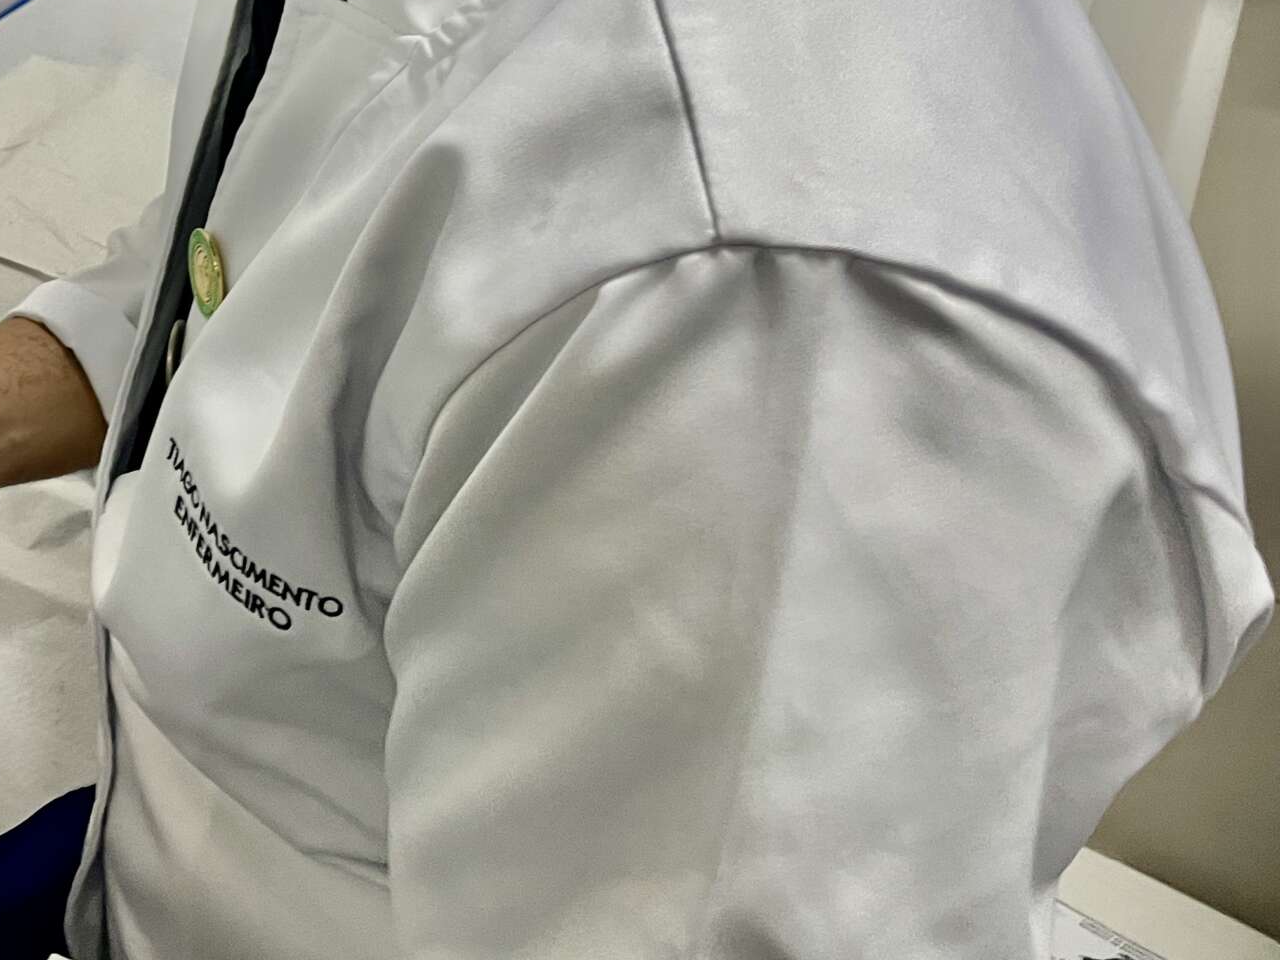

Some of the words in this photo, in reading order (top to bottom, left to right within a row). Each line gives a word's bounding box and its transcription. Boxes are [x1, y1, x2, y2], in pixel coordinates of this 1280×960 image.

[166, 437, 200, 509] TIAGO
[199, 501, 344, 618] NASCIMENTO
[174, 495, 292, 631] ENFERMEIRO
